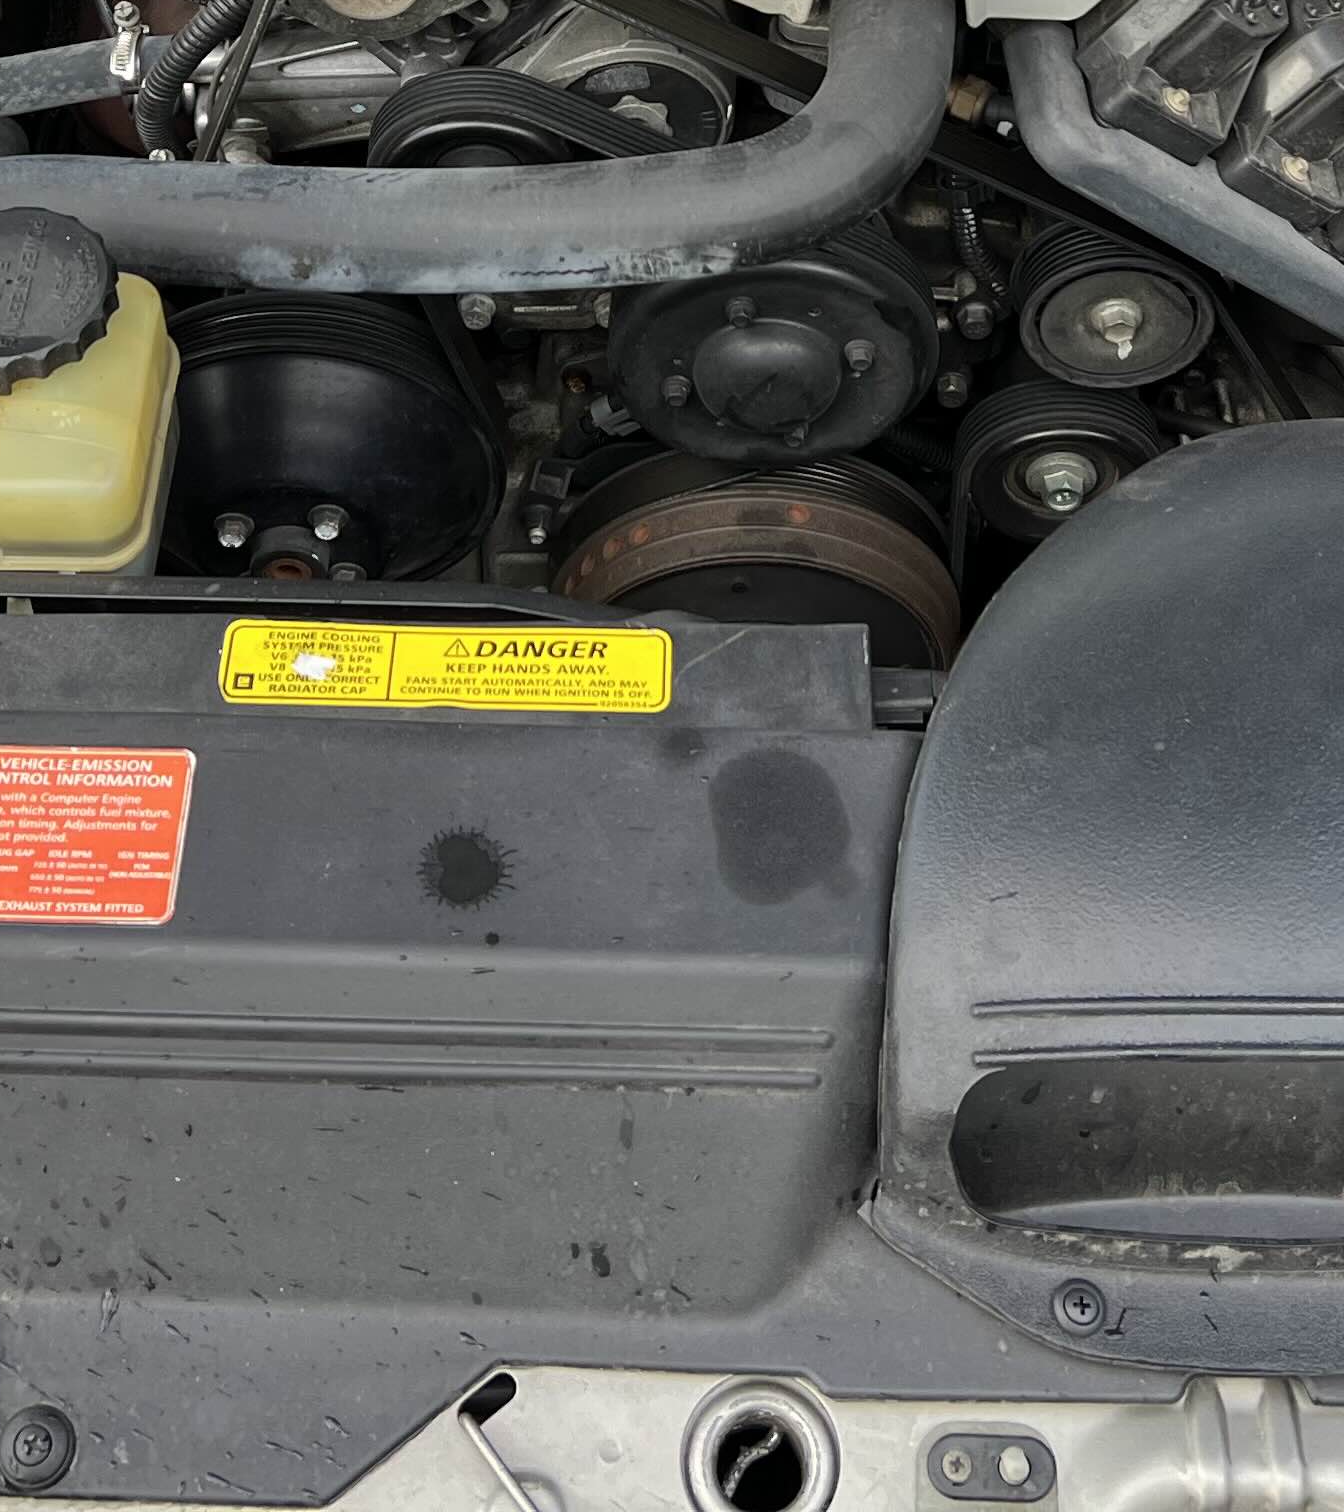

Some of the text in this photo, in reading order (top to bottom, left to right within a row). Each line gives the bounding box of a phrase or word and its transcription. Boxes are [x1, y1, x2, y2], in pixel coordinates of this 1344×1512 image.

[269, 631, 381, 643] ENGINE COOLING
[263, 641, 385, 653] SYSTEM PRESSURE
[475, 639, 608, 659] DANGER
[271, 652, 288, 660] V6
[349, 656, 373, 664] kPa
[269, 663, 371, 674] V8 kPa
[446, 663, 609, 676] KEEP HANDS AWAY.
[258, 674, 281, 682] USE
[406, 676, 647, 690] FANS START AUTOMATICALLY, AND MAY
[268, 684, 367, 695] RADIATOR CAP
[400, 685, 462, 696] CONTINUE
[466, 686, 481, 696] TO
[485, 687, 510, 697] RUN
[514, 688, 551, 698] WHEN
[555, 688, 609, 699] IGNITION
[613, 690, 624, 699] IS
[0, 756, 153, 773] VEHICLE-EMISSION
[57, 773, 173, 788] INFORMATION
[1, 792, 26, 802] with
[40, 793, 99, 805] Computer
[102, 794, 142, 807] Engine
[10, 805, 45, 816] which
[49, 806, 96, 817] controls
[99, 807, 122, 817] fuel
[125, 808, 172, 819] mixture,
[18, 819, 59, 831] timing.
[63, 819, 136, 832] Adjustments
[140, 821, 158, 831] for
[13, 831, 68, 844] provided.
[14, 848, 35, 857] GAP
[55, 902, 101, 913] SYSTEM
[104, 903, 144, 915] FITTED
